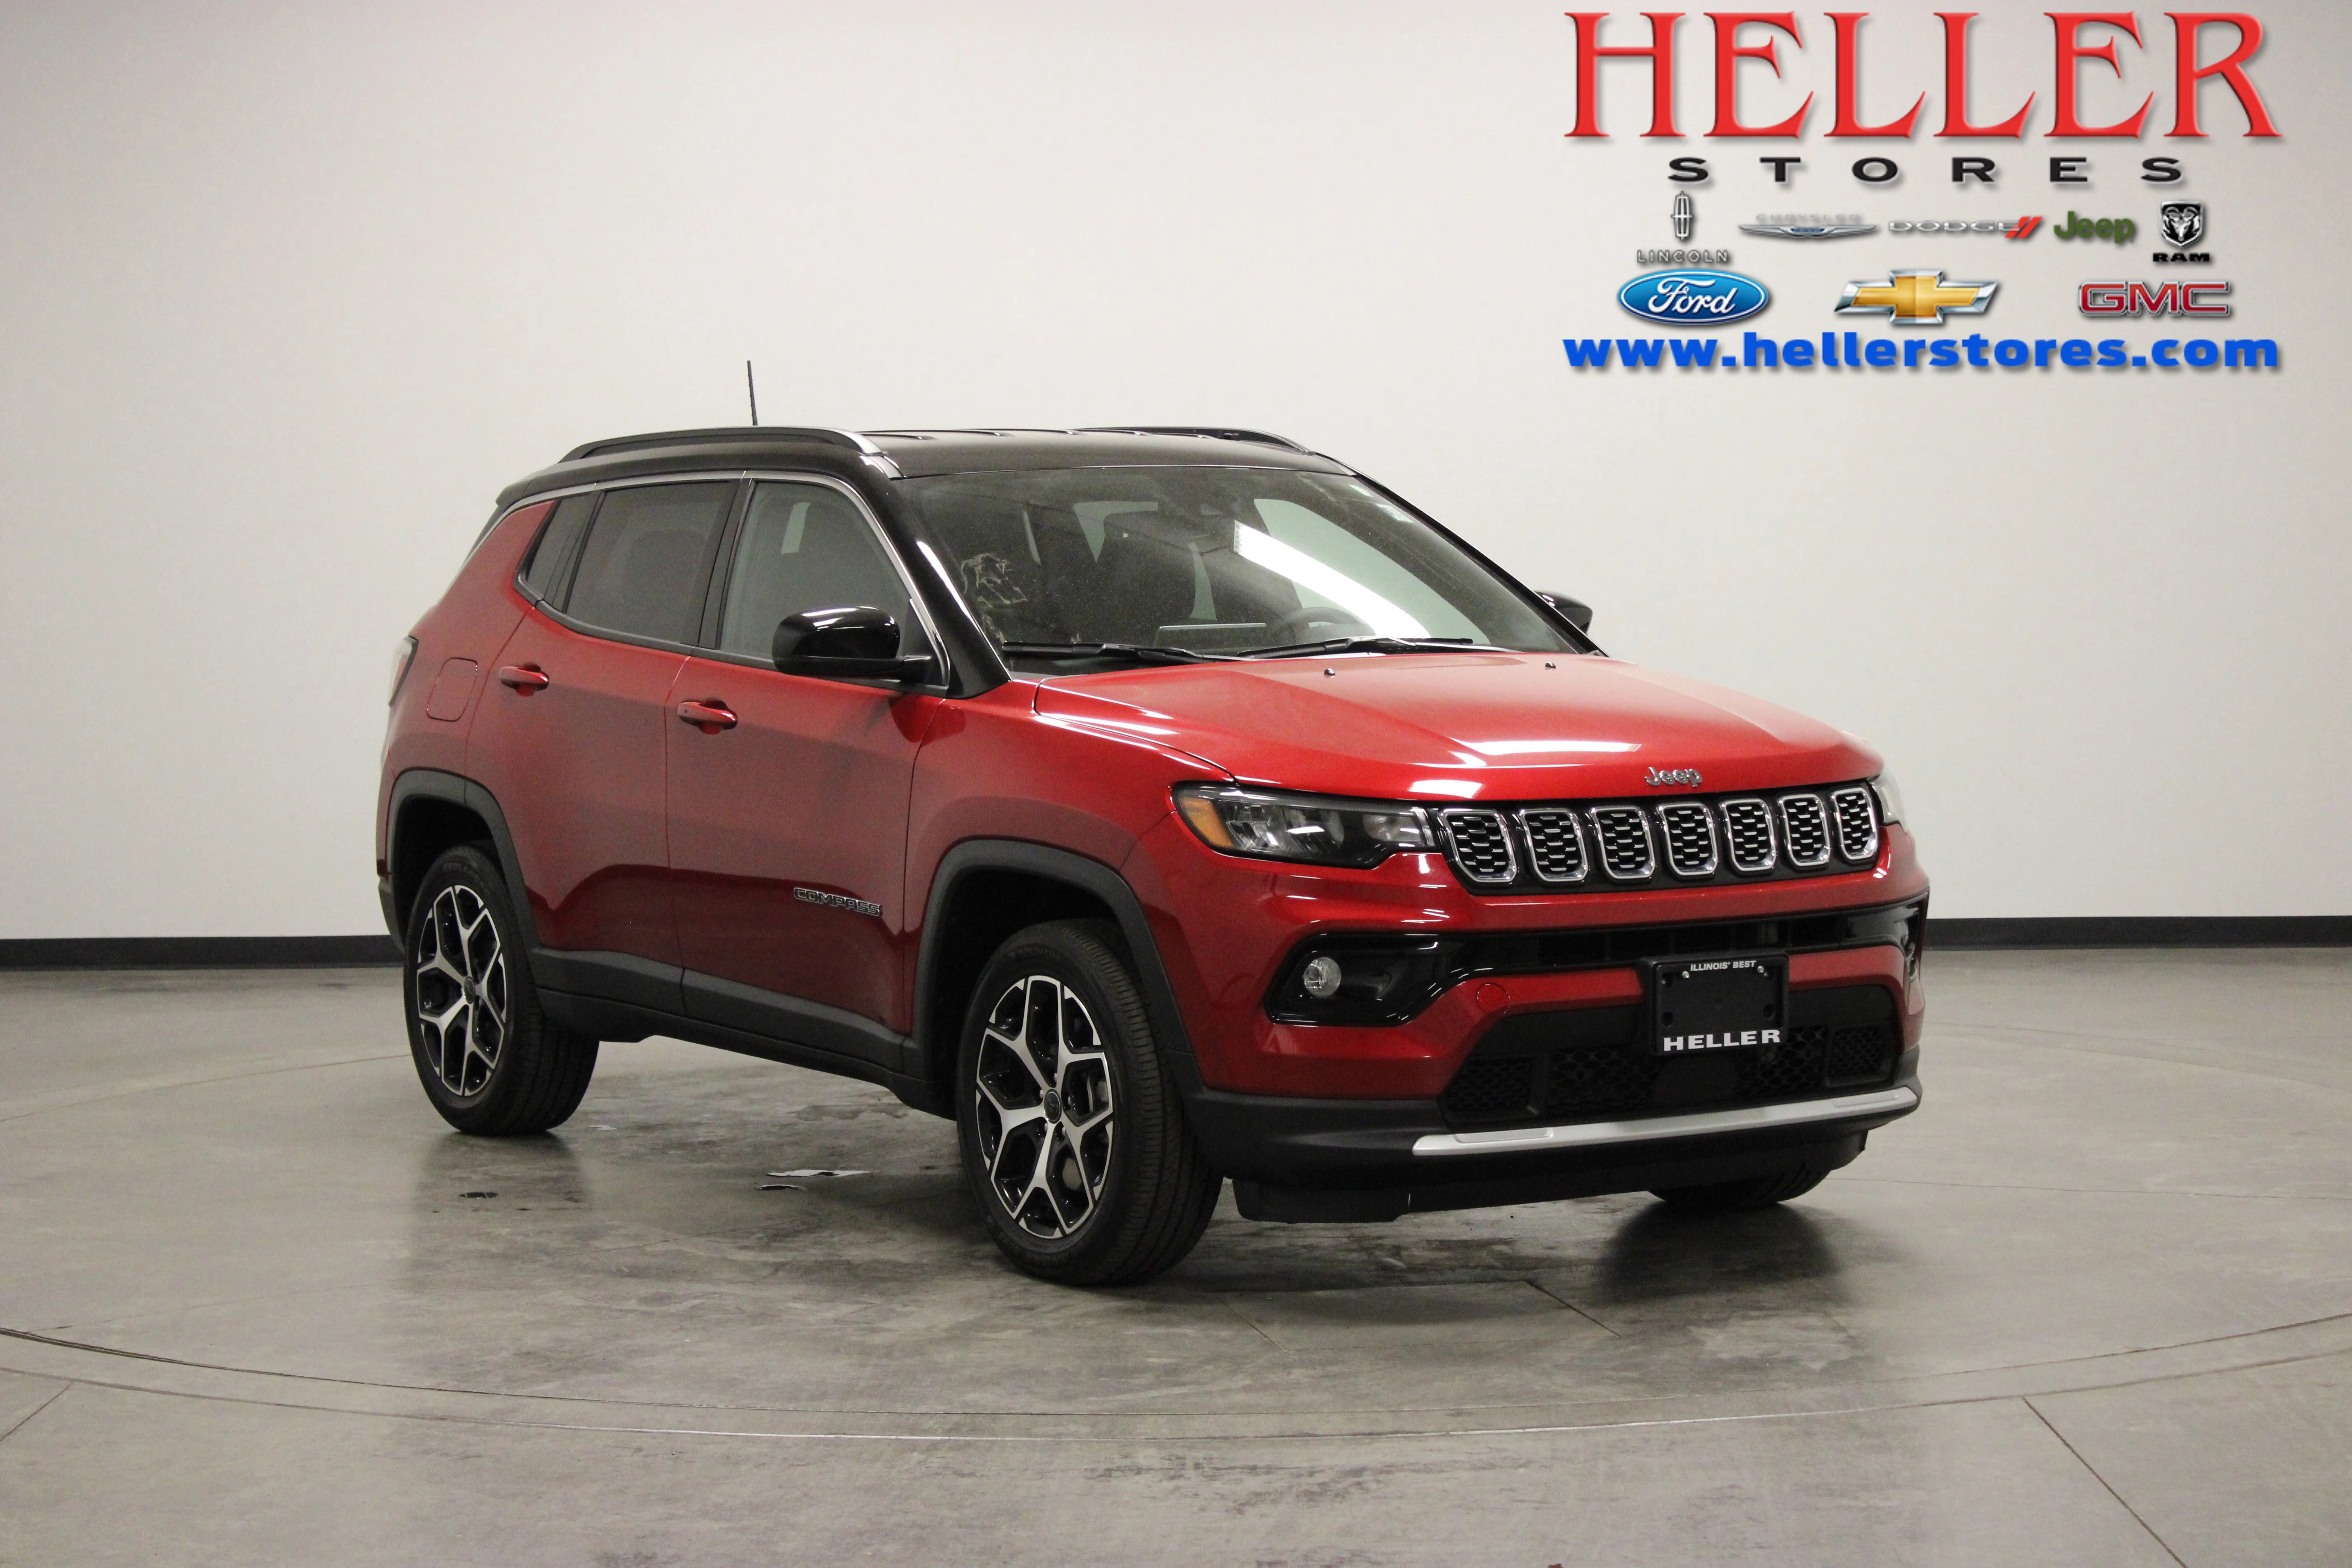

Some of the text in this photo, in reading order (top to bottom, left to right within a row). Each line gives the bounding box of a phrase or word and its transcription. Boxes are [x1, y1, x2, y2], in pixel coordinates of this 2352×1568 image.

[1644, 766, 1702, 787] Jeep
[793, 887, 883, 916] COMPASS
[1732, 960, 1757, 969] BEST
[1663, 1029, 1781, 1051] HELLER
